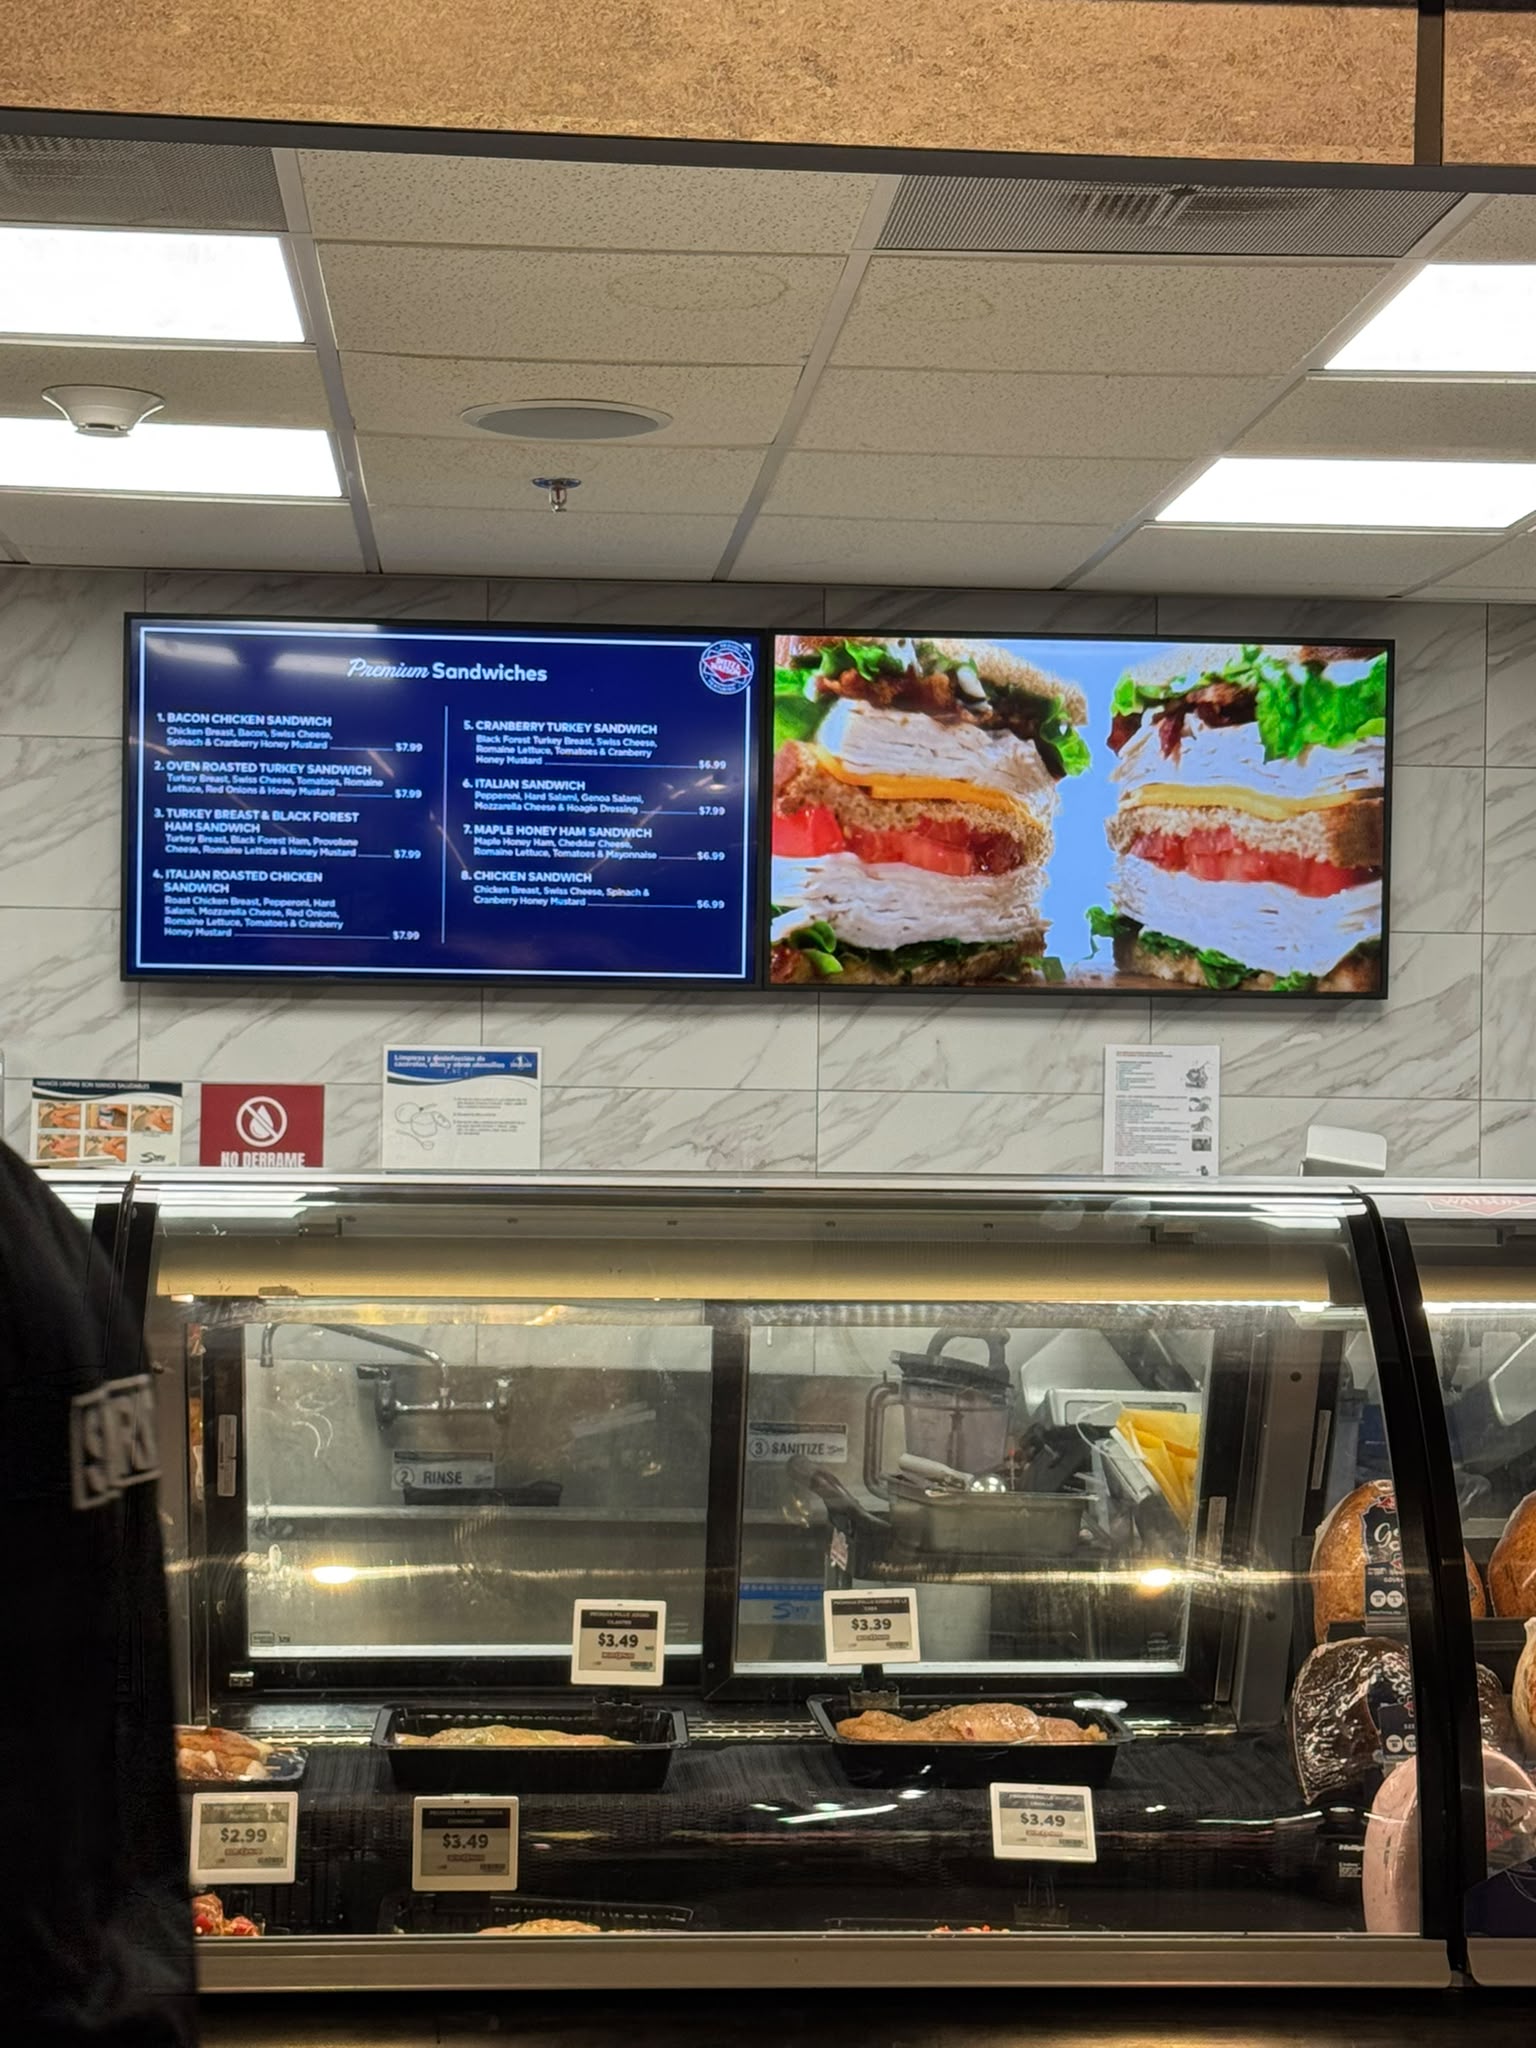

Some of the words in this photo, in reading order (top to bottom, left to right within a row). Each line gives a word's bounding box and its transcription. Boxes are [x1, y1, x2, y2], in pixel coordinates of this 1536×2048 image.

[347, 659, 430, 679] Premium
[432, 663, 548, 683] Sandwiches
[157, 713, 165, 722] 1.
[166, 713, 209, 723] BACON
[211, 714, 265, 725] CHICKEN
[266, 716, 333, 726] SANDWICH
[167, 727, 203, 736] Chicken
[270, 729, 295, 738] Swiss
[463, 720, 473, 730] 5.
[475, 721, 545, 731] CRANBERRY
[546, 722, 592, 733] TURKEY
[593, 723, 658, 734] SANDWICH
[167, 738, 203, 748] Spinach
[204, 739, 211, 749] &
[213, 739, 258, 749] Cranberry
[260, 740, 289, 750] Honey
[291, 740, 328, 749] Mustard
[395, 742, 423, 752] $7.99
[476, 735, 500, 743] Black
[502, 736, 531, 744] Forest
[532, 736, 562, 746] Turkey
[596, 738, 620, 746] Swiss
[476, 745, 515, 753] Romaine
[554, 747, 597, 755] Tomatoes
[599, 748, 606, 758] &
[607, 749, 652, 758] Cranberry
[154, 761, 164, 771] 2.
[166, 761, 200, 771] OVEN
[202, 762, 257, 772] ROASTED
[259, 763, 305, 773] TURKEY
[306, 764, 372, 775] SANDWICH
[476, 756, 504, 766] Honey
[506, 756, 543, 765] Mustard
[699, 760, 727, 769] $6.99
[167, 773, 197, 784] Turkey
[232, 775, 257, 784] Swiss
[343, 778, 384, 787] Romaine
[462, 778, 473, 788] 6.
[474, 779, 519, 789] ITALIAN
[521, 780, 586, 790] SANDWICH
[205, 785, 223, 794] Red
[225, 786, 257, 795] Onions
[259, 787, 266, 797] &
[267, 787, 297, 797] Honey
[298, 787, 335, 796] Mustard
[394, 789, 422, 798] $7.99
[524, 792, 546, 801] Hard
[581, 794, 610, 802] Genoa
[154, 808, 164, 818] 3.
[166, 808, 212, 819] TURKEY
[213, 809, 259, 820] BREAST
[260, 811, 270, 822] &
[271, 811, 311, 821] BLACK
[312, 812, 359, 822] FOREST
[474, 802, 521, 811] Mozzarella
[523, 803, 556, 812] Cheese
[557, 804, 564, 814] &
[566, 804, 598, 814] Hoagie
[599, 805, 638, 815] Dressing
[699, 806, 726, 815] $7.99
[165, 822, 193, 831] HAM
[194, 822, 260, 833] SANDWICH
[463, 824, 472, 834] 7.
[474, 825, 514, 835] MAPLE
[515, 826, 557, 836] HONEY
[559, 826, 586, 836] HAM
[588, 827, 652, 838] SANDWICH
[166, 834, 196, 845] Turkey
[230, 835, 255, 845] Black
[257, 836, 286, 845] Forest
[312, 838, 359, 847] Provolone
[474, 837, 501, 847] Maple
[502, 838, 531, 848] Honey
[558, 839, 595, 848] Cheddar
[202, 846, 242, 854] Romaine
[244, 847, 278, 855] Lettuce
[280, 848, 287, 858] &
[288, 848, 318, 858] Honey
[319, 848, 357, 857] Mustard
[394, 849, 421, 859] $7.99
[474, 848, 513, 856] Romaine
[552, 850, 595, 858] Tomatoes
[597, 851, 603, 861] &
[605, 851, 657, 861] Mayonnaise
[697, 851, 726, 860] $6.99
[153, 869, 163, 879] 4.
[165, 869, 210, 880] ITALIAN
[212, 870, 268, 881] ROASTED
[269, 872, 323, 882] CHICKEN
[461, 871, 471, 880] 8.
[473, 871, 526, 881] CHICKEN
[528, 872, 592, 882] SANDWICH
[164, 883, 230, 893] SANDWICH
[474, 885, 509, 894] Chicken
[543, 887, 568, 895] Swiss
[606, 888, 641, 898] Spinach
[164, 896, 190, 904] Roast
[192, 897, 228, 905] Chicken
[313, 899, 336, 908] Hard
[474, 896, 518, 906] Cranberry
[519, 897, 548, 907] Honey
[550, 897, 586, 906] Mustard
[697, 900, 725, 909] $6.99
[198, 908, 246, 916] Mozzarella
[285, 908, 303, 917] Red
[164, 928, 193, 938] Honey
[195, 928, 232, 937] Mustard
[393, 931, 420, 940] $7.99
[221, 1151, 239, 1168] NO
[242, 1152, 306, 1168] DERRAME
[755, 1442, 763, 1454] 3
[772, 1442, 824, 1455] SANITIZE
[400, 1471, 408, 1482] 2
[423, 1471, 462, 1484] RINSE
[852, 1618, 892, 1631] $3.39
[598, 1632, 638, 1648] $3.49
[1020, 1812, 1065, 1827] $3.49
[221, 1828, 267, 1843] $2.99
[443, 1832, 488, 1849] $3.49
